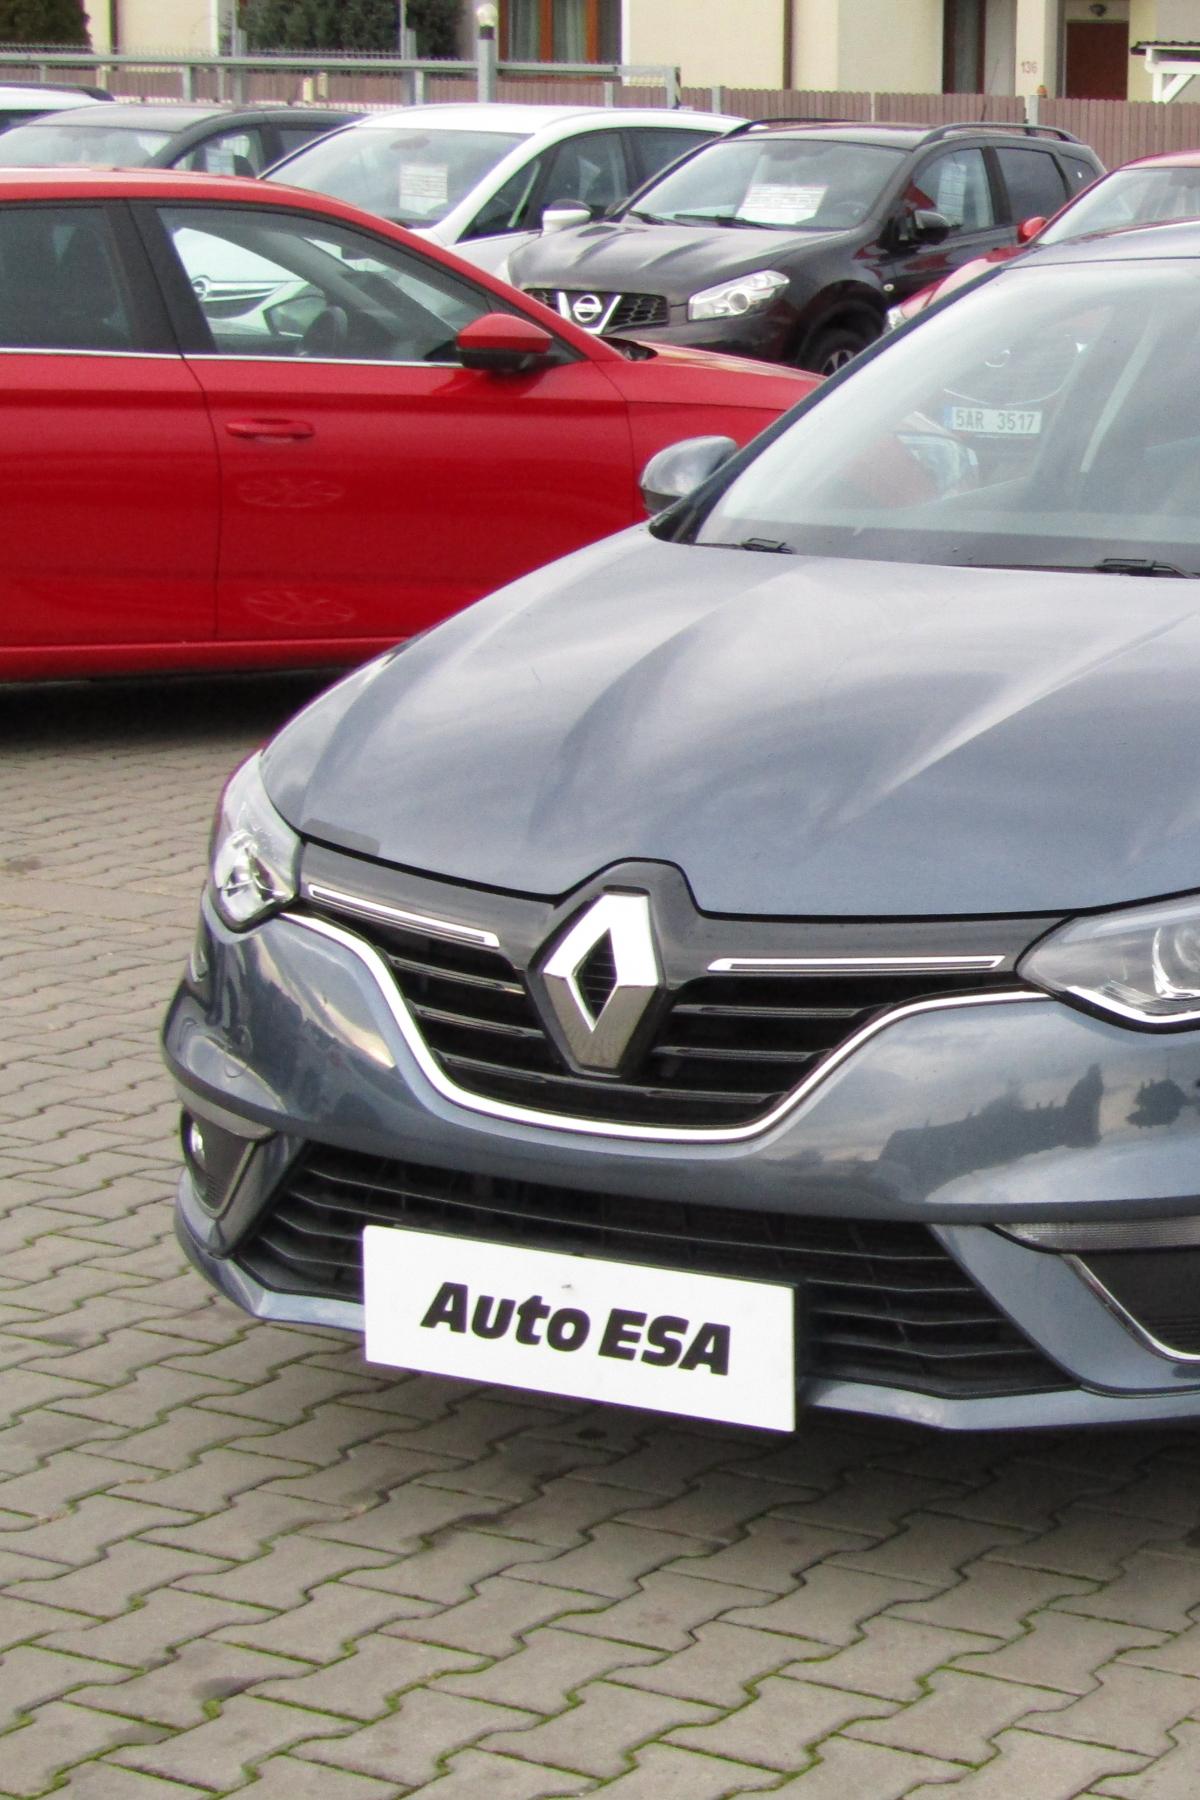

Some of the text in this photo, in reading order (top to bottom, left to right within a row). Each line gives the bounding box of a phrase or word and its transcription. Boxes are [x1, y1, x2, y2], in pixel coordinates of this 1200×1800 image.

[955, 409, 1035, 432] 5AR 3517
[420, 1281, 731, 1376] Auto ESA
